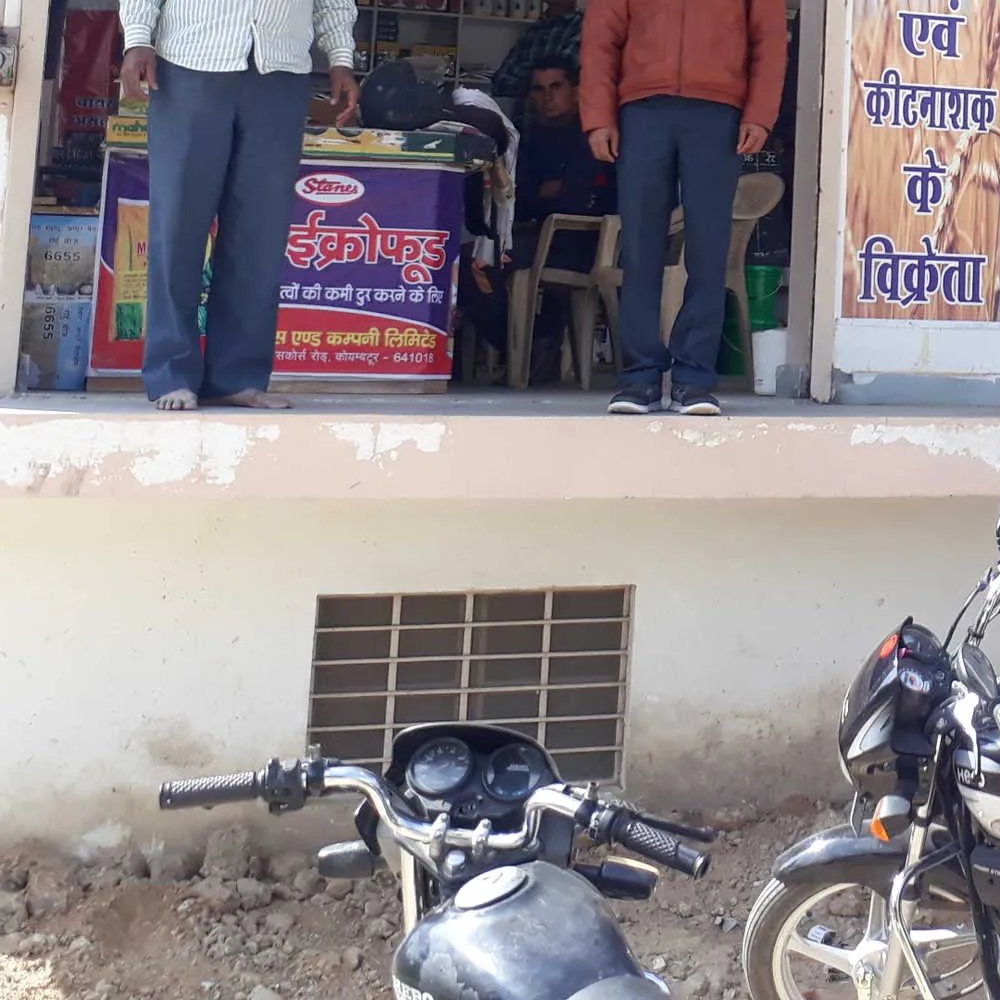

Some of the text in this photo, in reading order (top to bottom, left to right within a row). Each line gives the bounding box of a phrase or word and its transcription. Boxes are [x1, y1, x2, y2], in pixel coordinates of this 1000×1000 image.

[898, 0, 967, 59] एवं
[863, 70, 998, 133] कीटनाशक
[302, 177, 359, 195] Stanes
[903, 149, 949, 215] के
[44, 250, 81, 261] 6655
[284, 209, 453, 286] ईक्रोफूड
[858, 235, 989, 309] विक्रेता
[279, 281, 300, 301] त्वों
[301, 283, 323, 302] की
[324, 283, 354, 302] कमी
[374, 284, 406, 304] करने
[409, 285, 425, 304] के
[42, 305, 56, 341] 6655
[326, 327, 381, 348] कम्पनी
[384, 327, 438, 349] लिमिटेड
[393, 352, 435, 365] 641018
